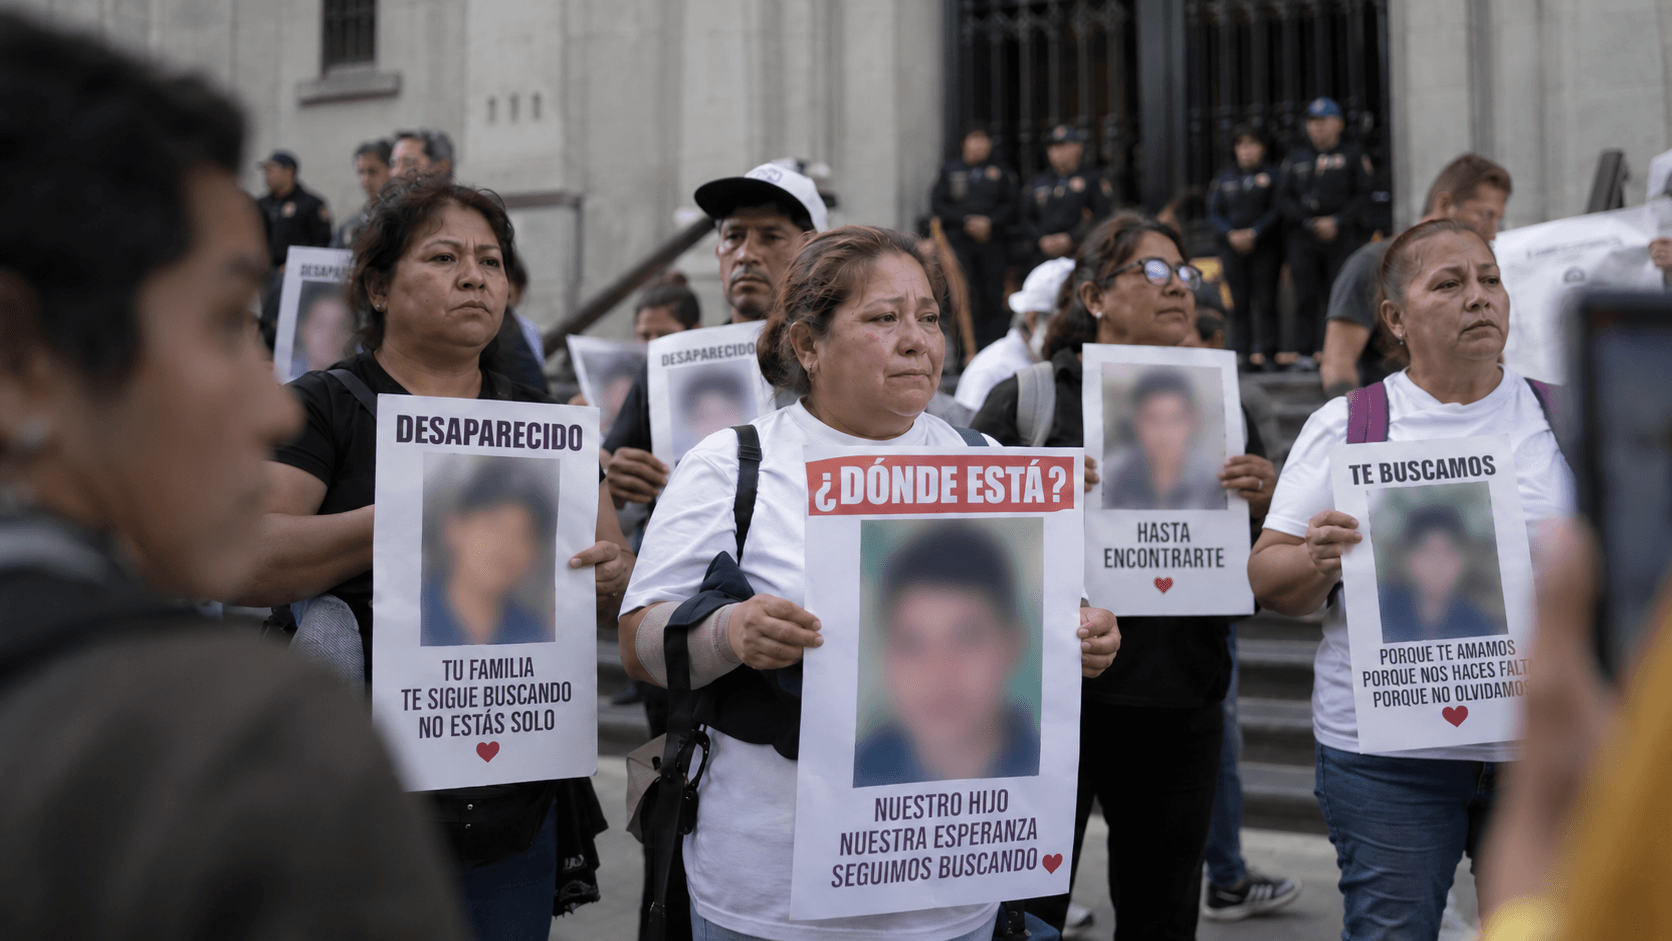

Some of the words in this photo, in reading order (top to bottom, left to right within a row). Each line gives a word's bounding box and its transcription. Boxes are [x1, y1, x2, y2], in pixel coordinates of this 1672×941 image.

[661, 342, 755, 367] DESAPARECIDO
[396, 414, 583, 451] DESAPARECIDO
[815, 457, 958, 512] ¿DÓNDE
[967, 459, 1067, 504] ESTÁ?
[1348, 464, 1374, 485] TE
[1379, 455, 1496, 483] BUSCAMOS
[1138, 522, 1191, 543] HASTA
[1104, 547, 1225, 568] ENCONTRARTE
[1379, 645, 1434, 665] PORQUE
[1436, 643, 1454, 661] TE
[1457, 639, 1516, 660] AMAMOS
[442, 659, 464, 681] TU
[469, 656, 534, 680] FAMILIA
[1362, 667, 1417, 687] PORQUE
[1420, 665, 1449, 684] NOS
[1452, 661, 1496, 681] HACES
[401, 688, 422, 711] TE
[427, 687, 478, 710] SIGUE
[483, 681, 572, 708] BUSCANDO
[1373, 687, 1428, 708] PORQUE
[1431, 685, 1450, 704] NO
[419, 715, 444, 739] NO
[450, 708, 505, 737] ESTÁS
[511, 709, 555, 733] SOLO
[874, 792, 962, 822] NUESTRO
[968, 788, 1009, 815] HIJO
[839, 826, 927, 856] NUESTRA
[933, 817, 1038, 849] ESPERANZA
[831, 856, 932, 888] SEGUIMOS
[938, 847, 1038, 879] BUSCANDO
